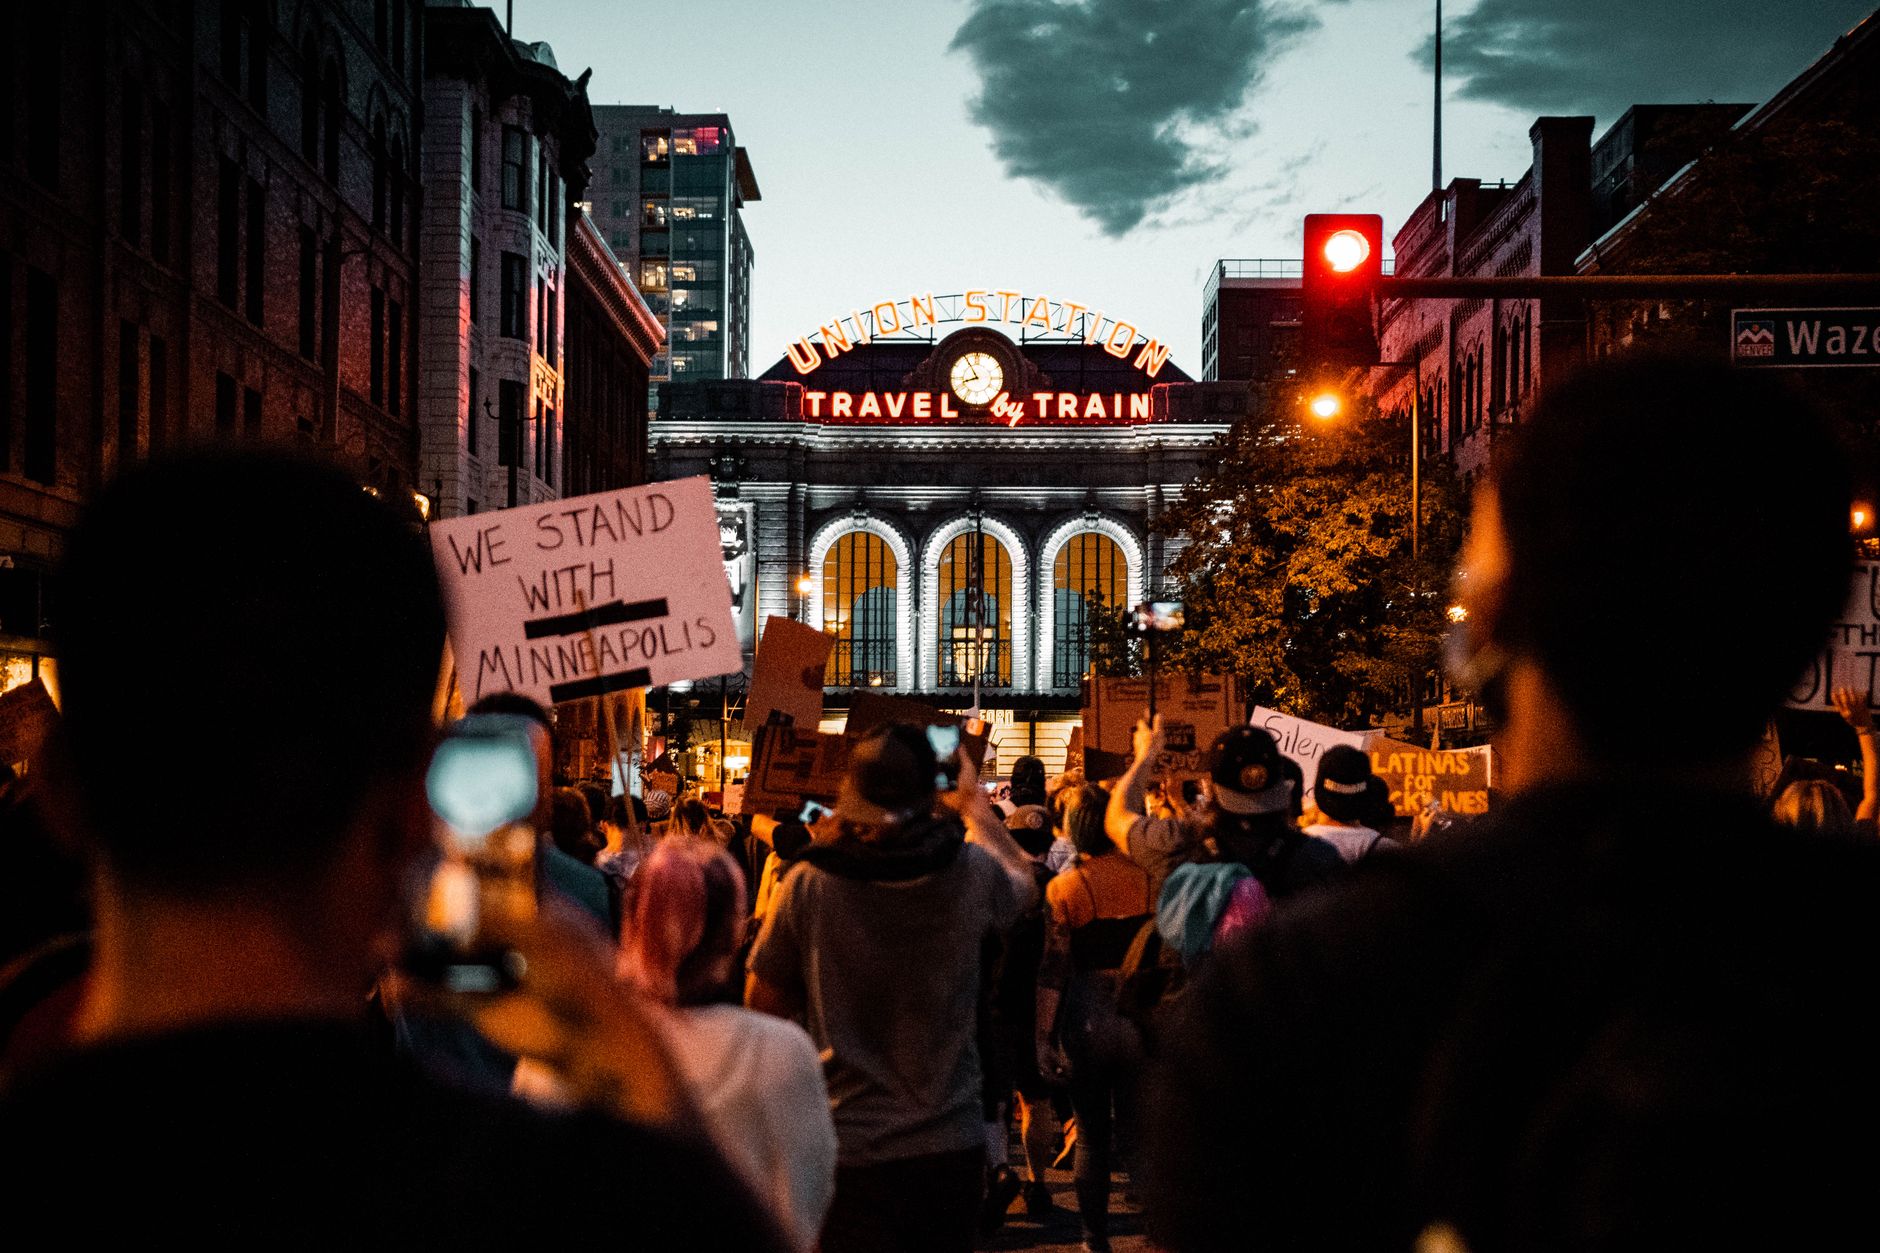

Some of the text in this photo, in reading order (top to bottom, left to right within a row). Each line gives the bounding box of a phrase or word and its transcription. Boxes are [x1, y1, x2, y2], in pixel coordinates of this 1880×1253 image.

[787, 289, 1172, 378] UNION STATION
[805, 391, 1151, 428] TRAVEL by TRAIN
[449, 493, 675, 575] WE STAND
[518, 557, 616, 613] WITH
[476, 616, 717, 699] MINNEAPOLIS
[1265, 715, 1326, 759] Silen
[1371, 752, 1470, 775] LATINAS
